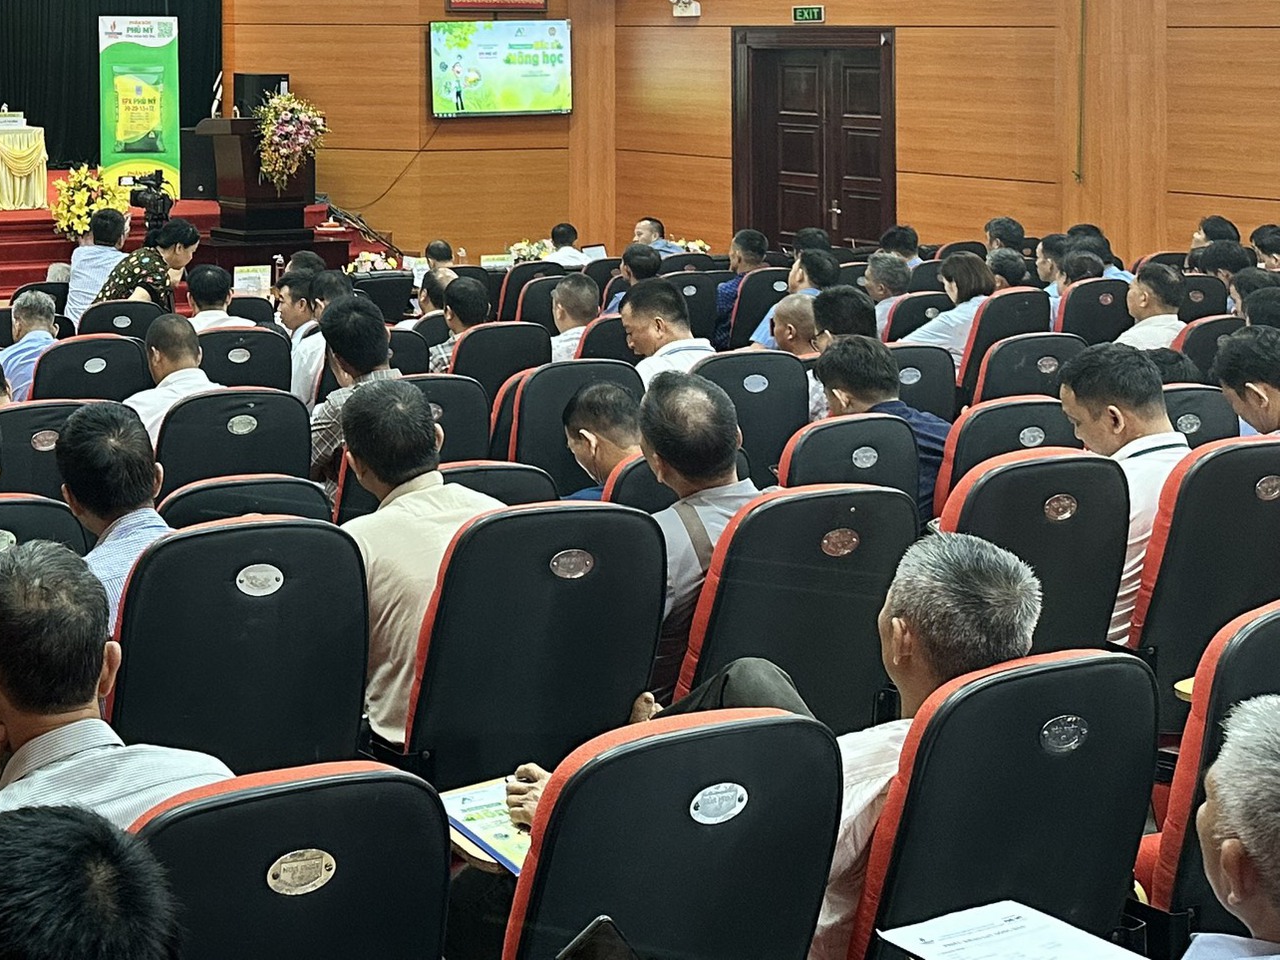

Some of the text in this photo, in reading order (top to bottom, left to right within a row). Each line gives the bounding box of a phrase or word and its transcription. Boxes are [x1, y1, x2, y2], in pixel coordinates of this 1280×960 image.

[796, 9, 819, 20] EXIT
[127, 25, 154, 34] PHÚ MỸ
[542, 51, 563, 67] học
